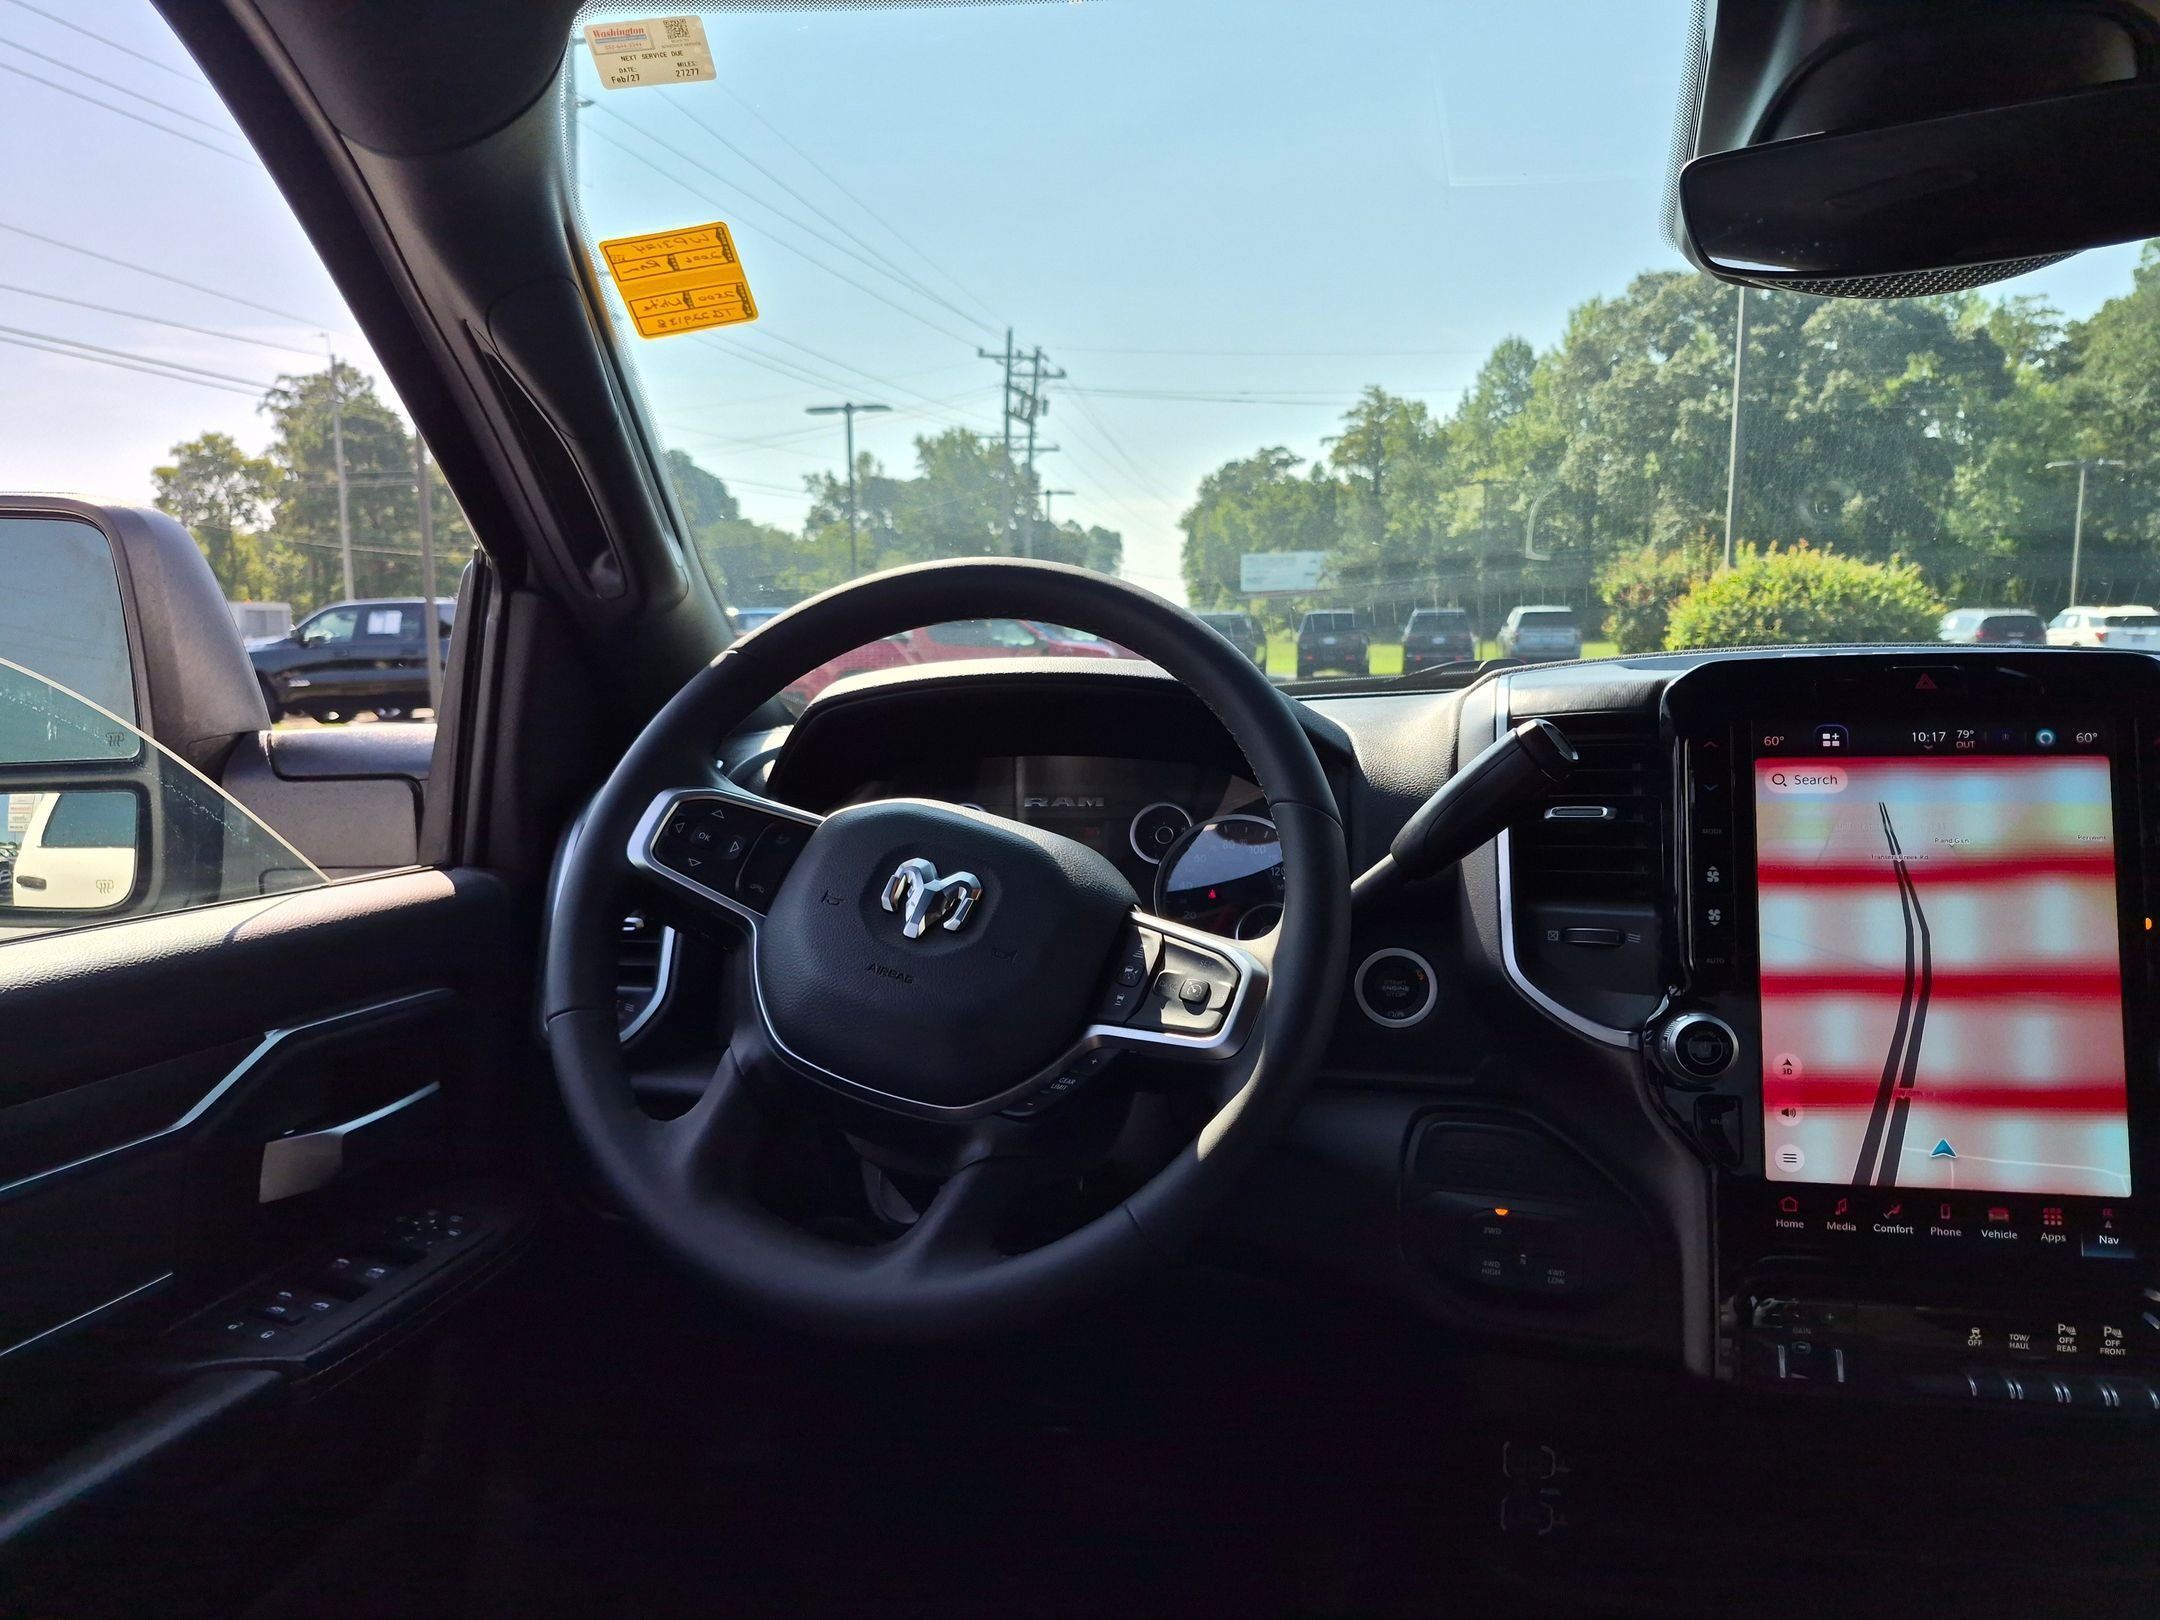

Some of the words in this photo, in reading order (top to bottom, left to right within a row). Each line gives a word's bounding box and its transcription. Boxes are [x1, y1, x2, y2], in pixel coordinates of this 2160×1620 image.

[592, 26, 645, 38] Washington
[641, 51, 668, 60] SERVICE
[675, 68, 699, 77] 27277
[611, 74, 640, 84] Feb/27
[1911, 731, 1946, 743] 10:17
[1956, 729, 1975, 739] 79°
[1956, 740, 1975, 749] OUT
[1794, 773, 1838, 785] Search
[1024, 797, 1105, 807] RAM
[698, 831, 712, 842] OK
[866, 962, 914, 985] AIRBAG
[1775, 1218, 1805, 1229] Home
[1826, 1221, 1857, 1232] Media
[1872, 1223, 1914, 1235] Comfort
[1930, 1226, 1962, 1237] Phone
[1981, 1228, 2018, 1240] Vehicle
[2040, 1232, 2067, 1244] Apps
[2098, 1234, 2120, 1245] Nav
[2008, 1333, 2030, 1342] TOW/
[2058, 1336, 2075, 1345] OFF
[1967, 1339, 1983, 1347] OFF
[2008, 1342, 2030, 1350] HAUL
[2104, 1339, 2121, 1347] OFF
[2056, 1344, 2078, 1353] REAR
[2099, 1347, 2126, 1356] FRONT
